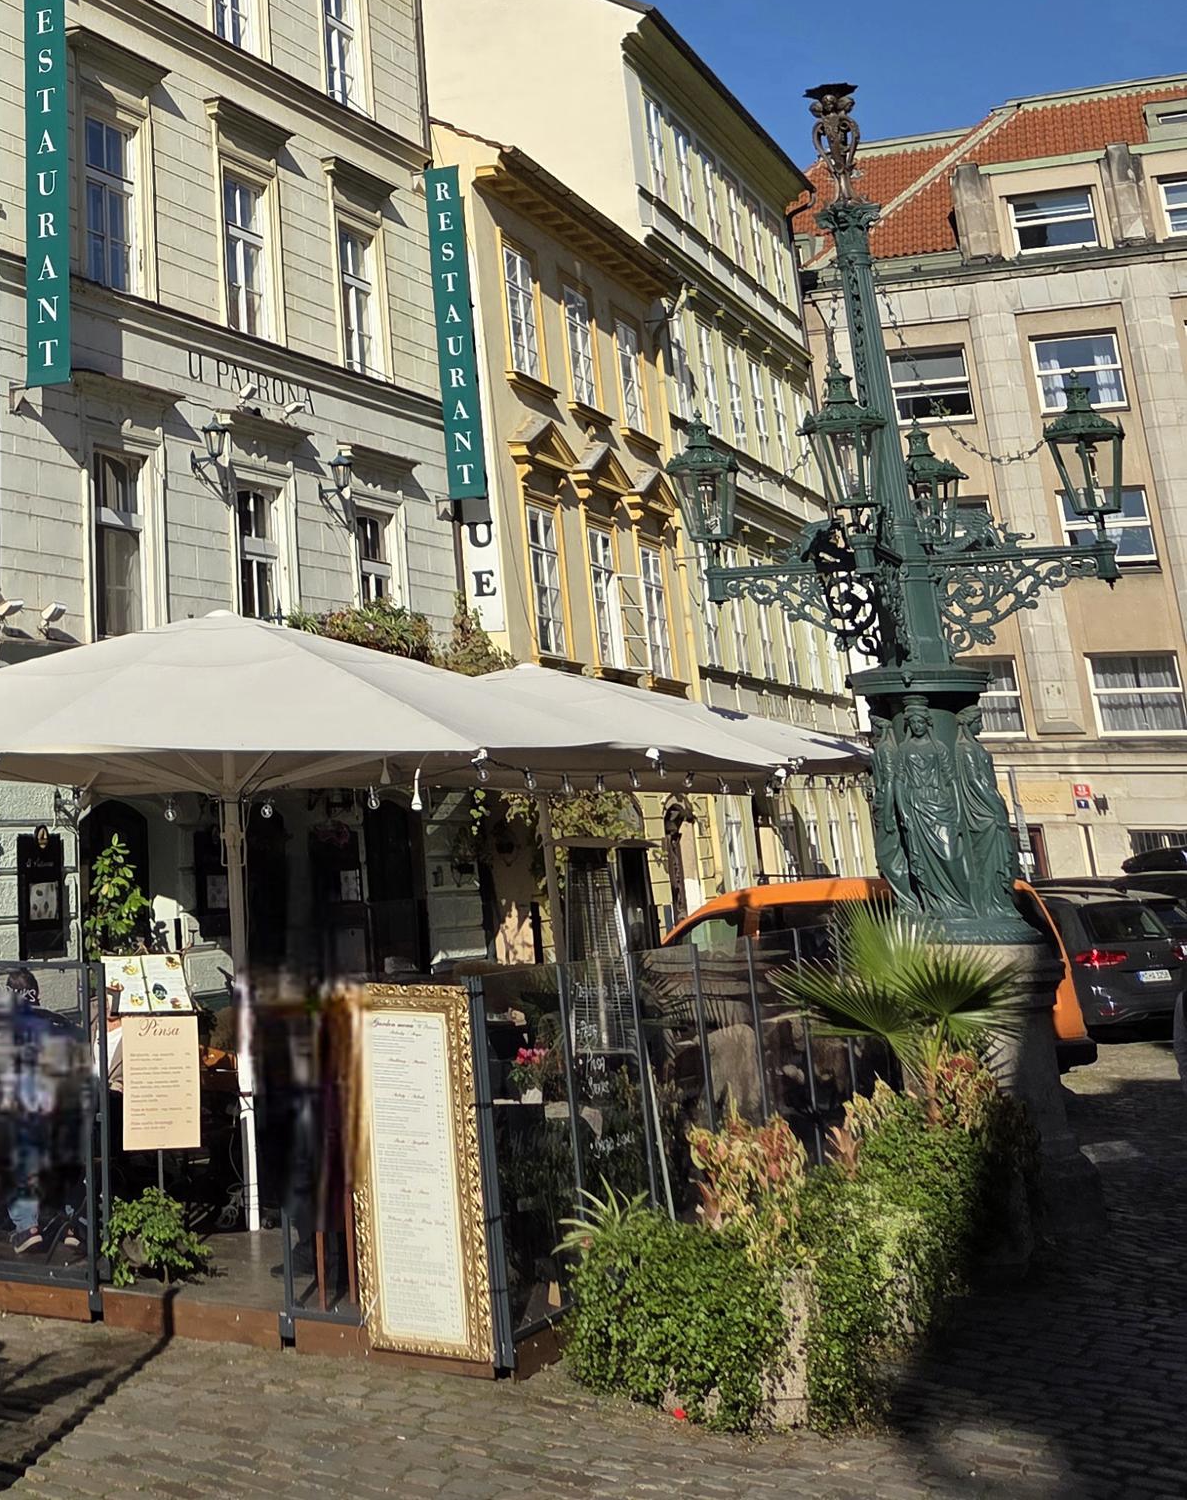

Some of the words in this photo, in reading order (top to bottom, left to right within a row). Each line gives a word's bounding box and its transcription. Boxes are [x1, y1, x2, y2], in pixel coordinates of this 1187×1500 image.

[434, 182, 475, 485] RESTAURANT
[188, 350, 203, 383] U
[215, 358, 316, 415] PATRONA
[138, 1018, 181, 1037] Pinsa
